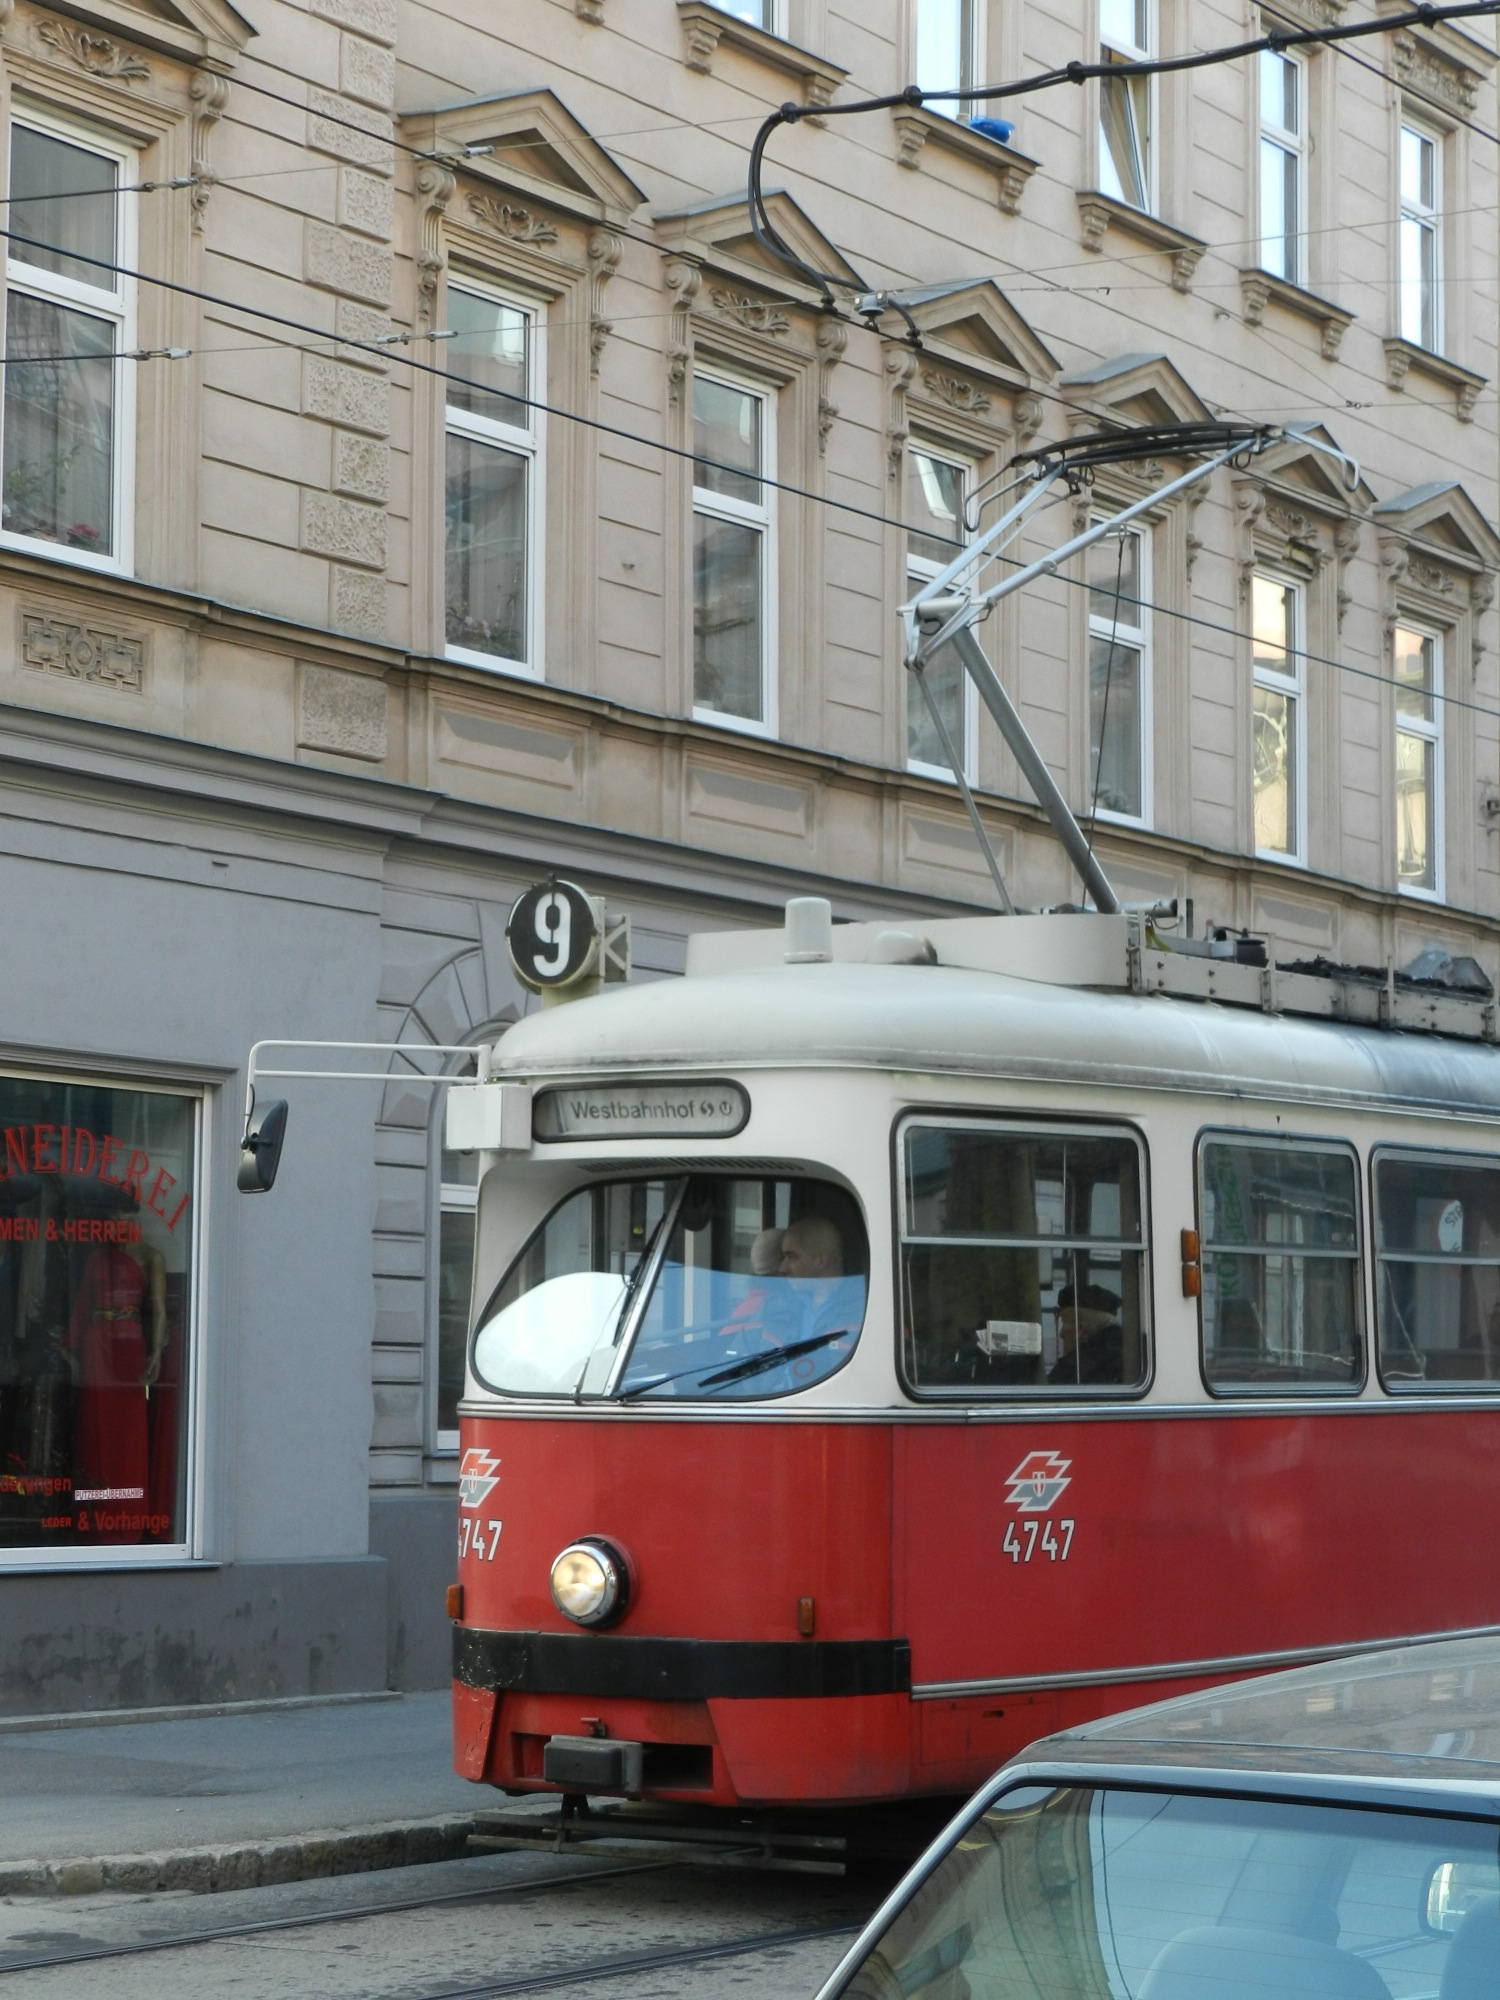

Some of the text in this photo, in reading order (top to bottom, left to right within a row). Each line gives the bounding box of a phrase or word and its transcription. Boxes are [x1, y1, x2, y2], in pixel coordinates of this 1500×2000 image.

[533, 892, 571, 977] 9
[570, 1100, 695, 1120] Westbahnhof
[0, 1124, 190, 1233] NEIDEREI
[45, 1218, 57, 1241] &
[64, 1219, 142, 1243] HERREN
[77, 1511, 89, 1531] &
[1002, 1519, 1075, 1563] 4747
